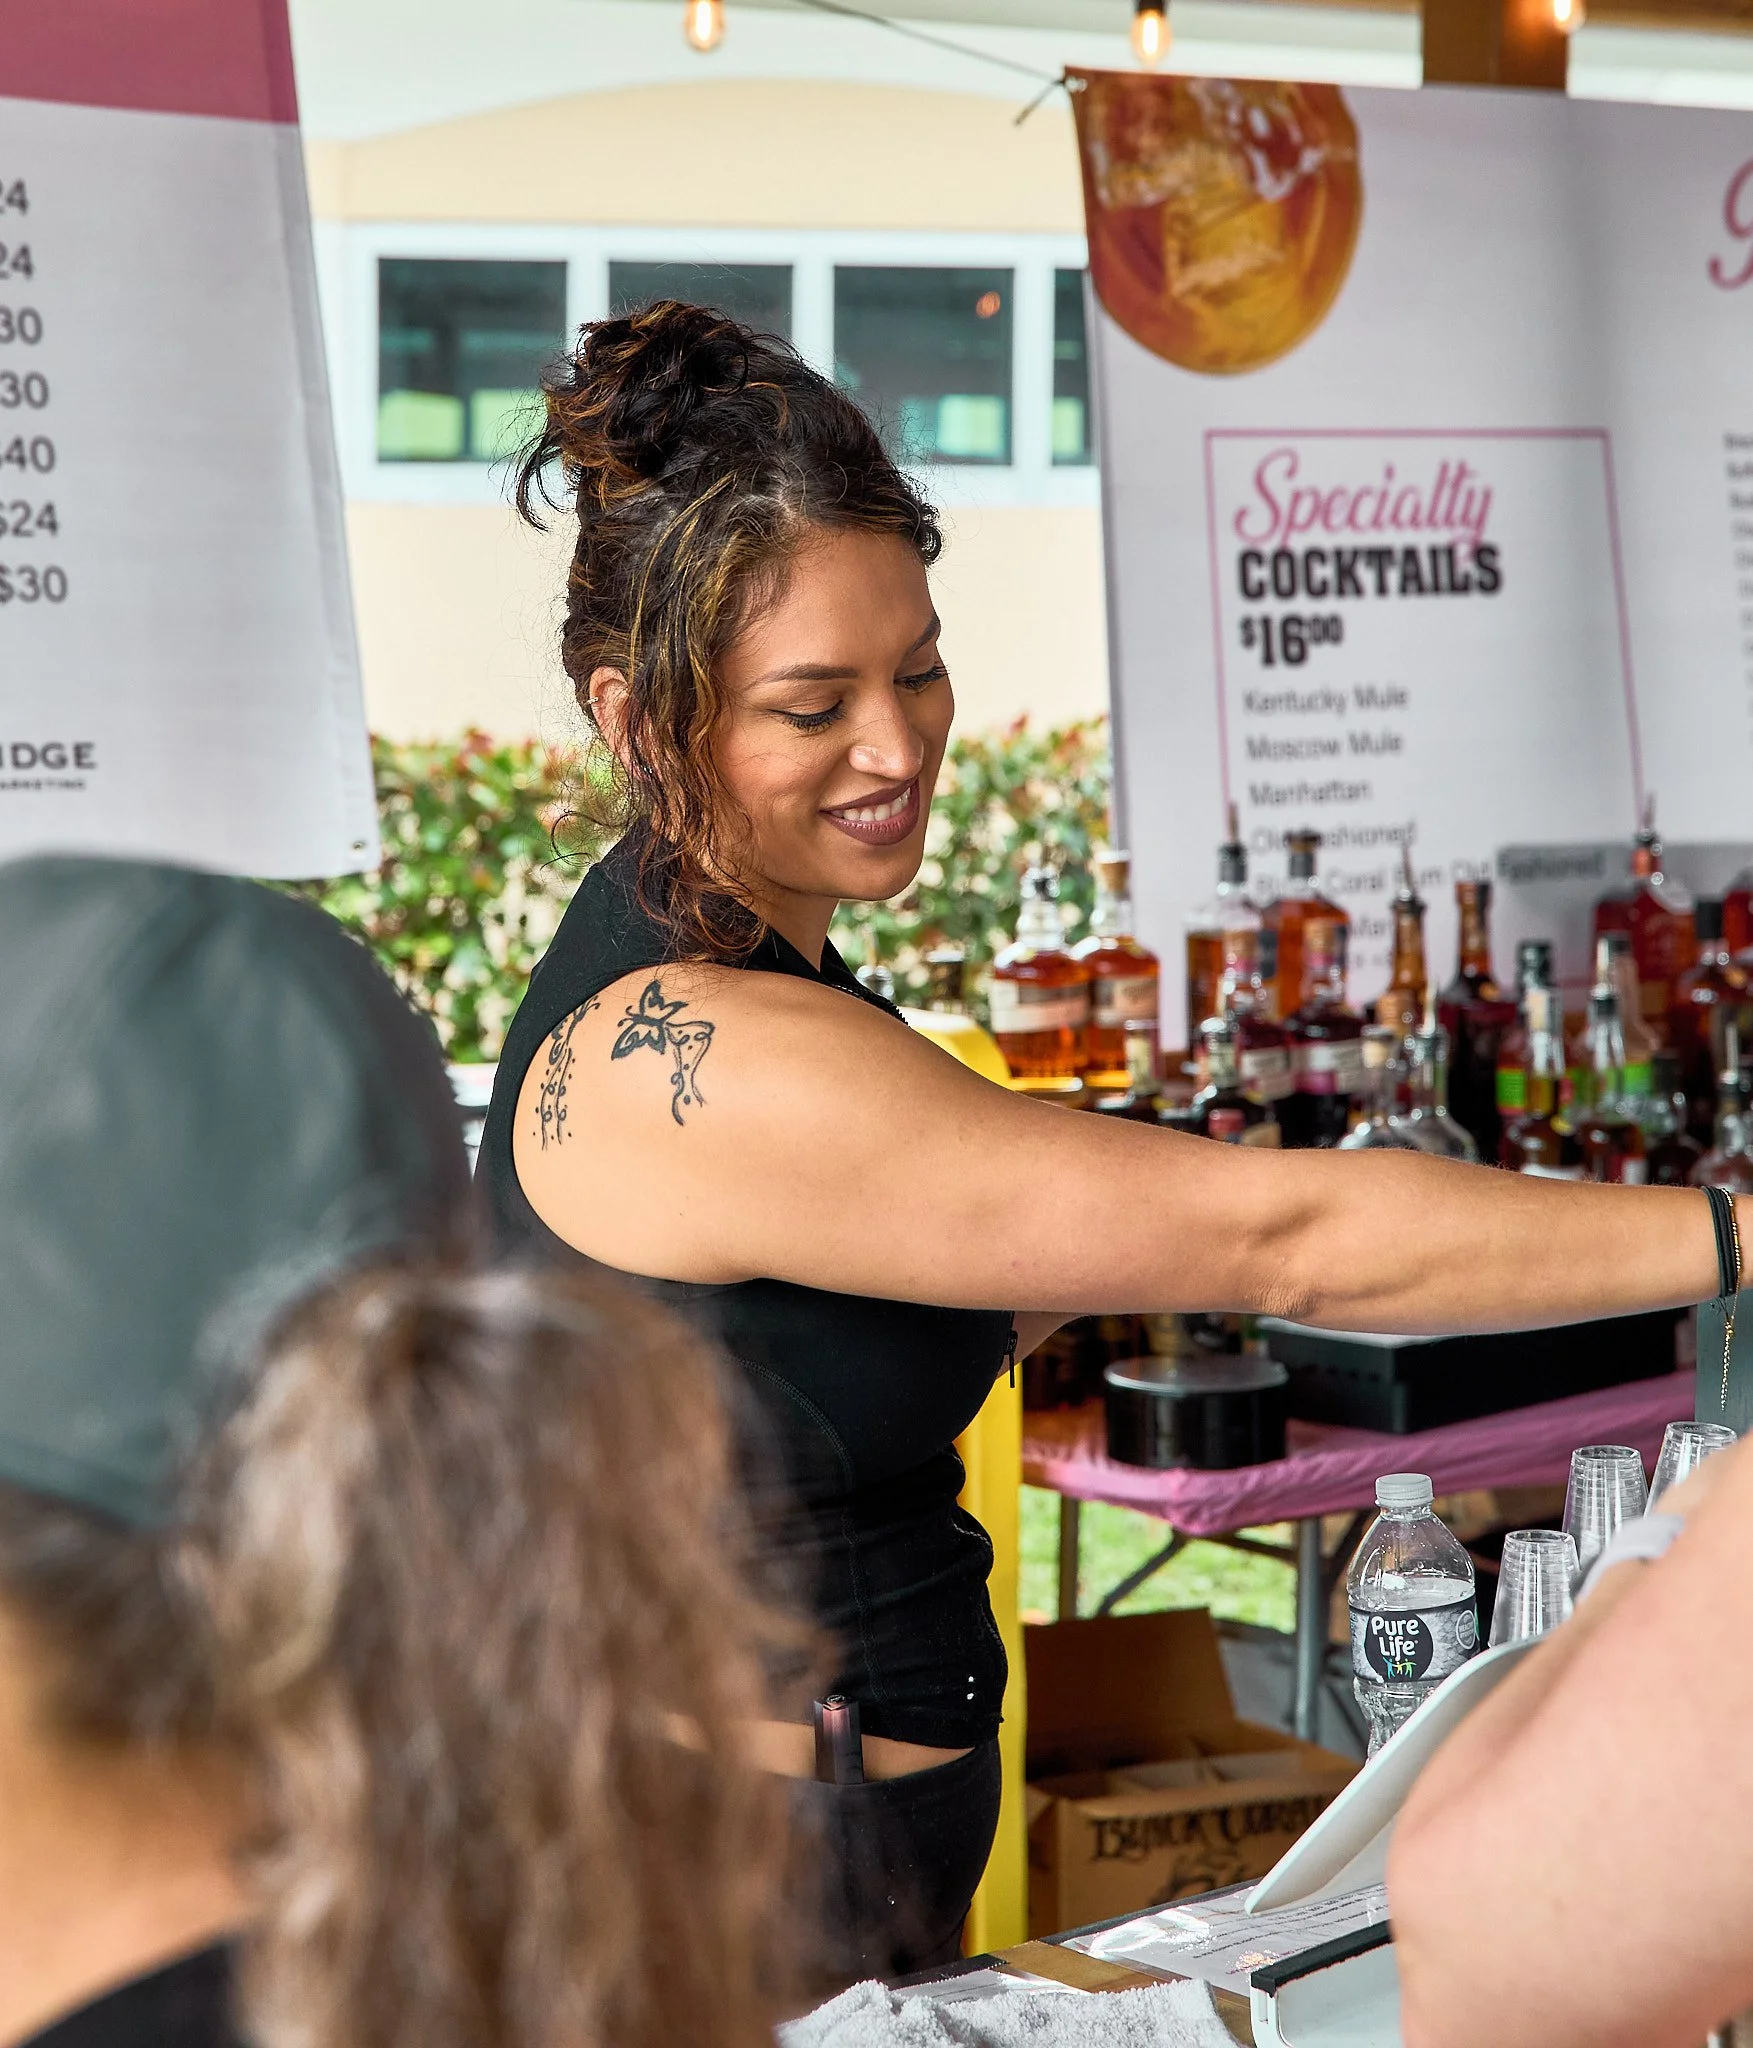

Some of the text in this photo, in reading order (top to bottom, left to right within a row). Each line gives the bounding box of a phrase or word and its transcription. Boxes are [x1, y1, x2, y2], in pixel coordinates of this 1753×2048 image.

[1233, 446, 1494, 566] Specialty
[1237, 544, 1504, 602] COCKTAILS
[1244, 681, 1410, 719] Kentucky Mule
[1246, 729, 1403, 762] Moscow Mule
[1248, 779, 1371, 808] Manhattan
[1371, 1615, 1420, 1636] Pure
[1379, 1635, 1416, 1661] Life
